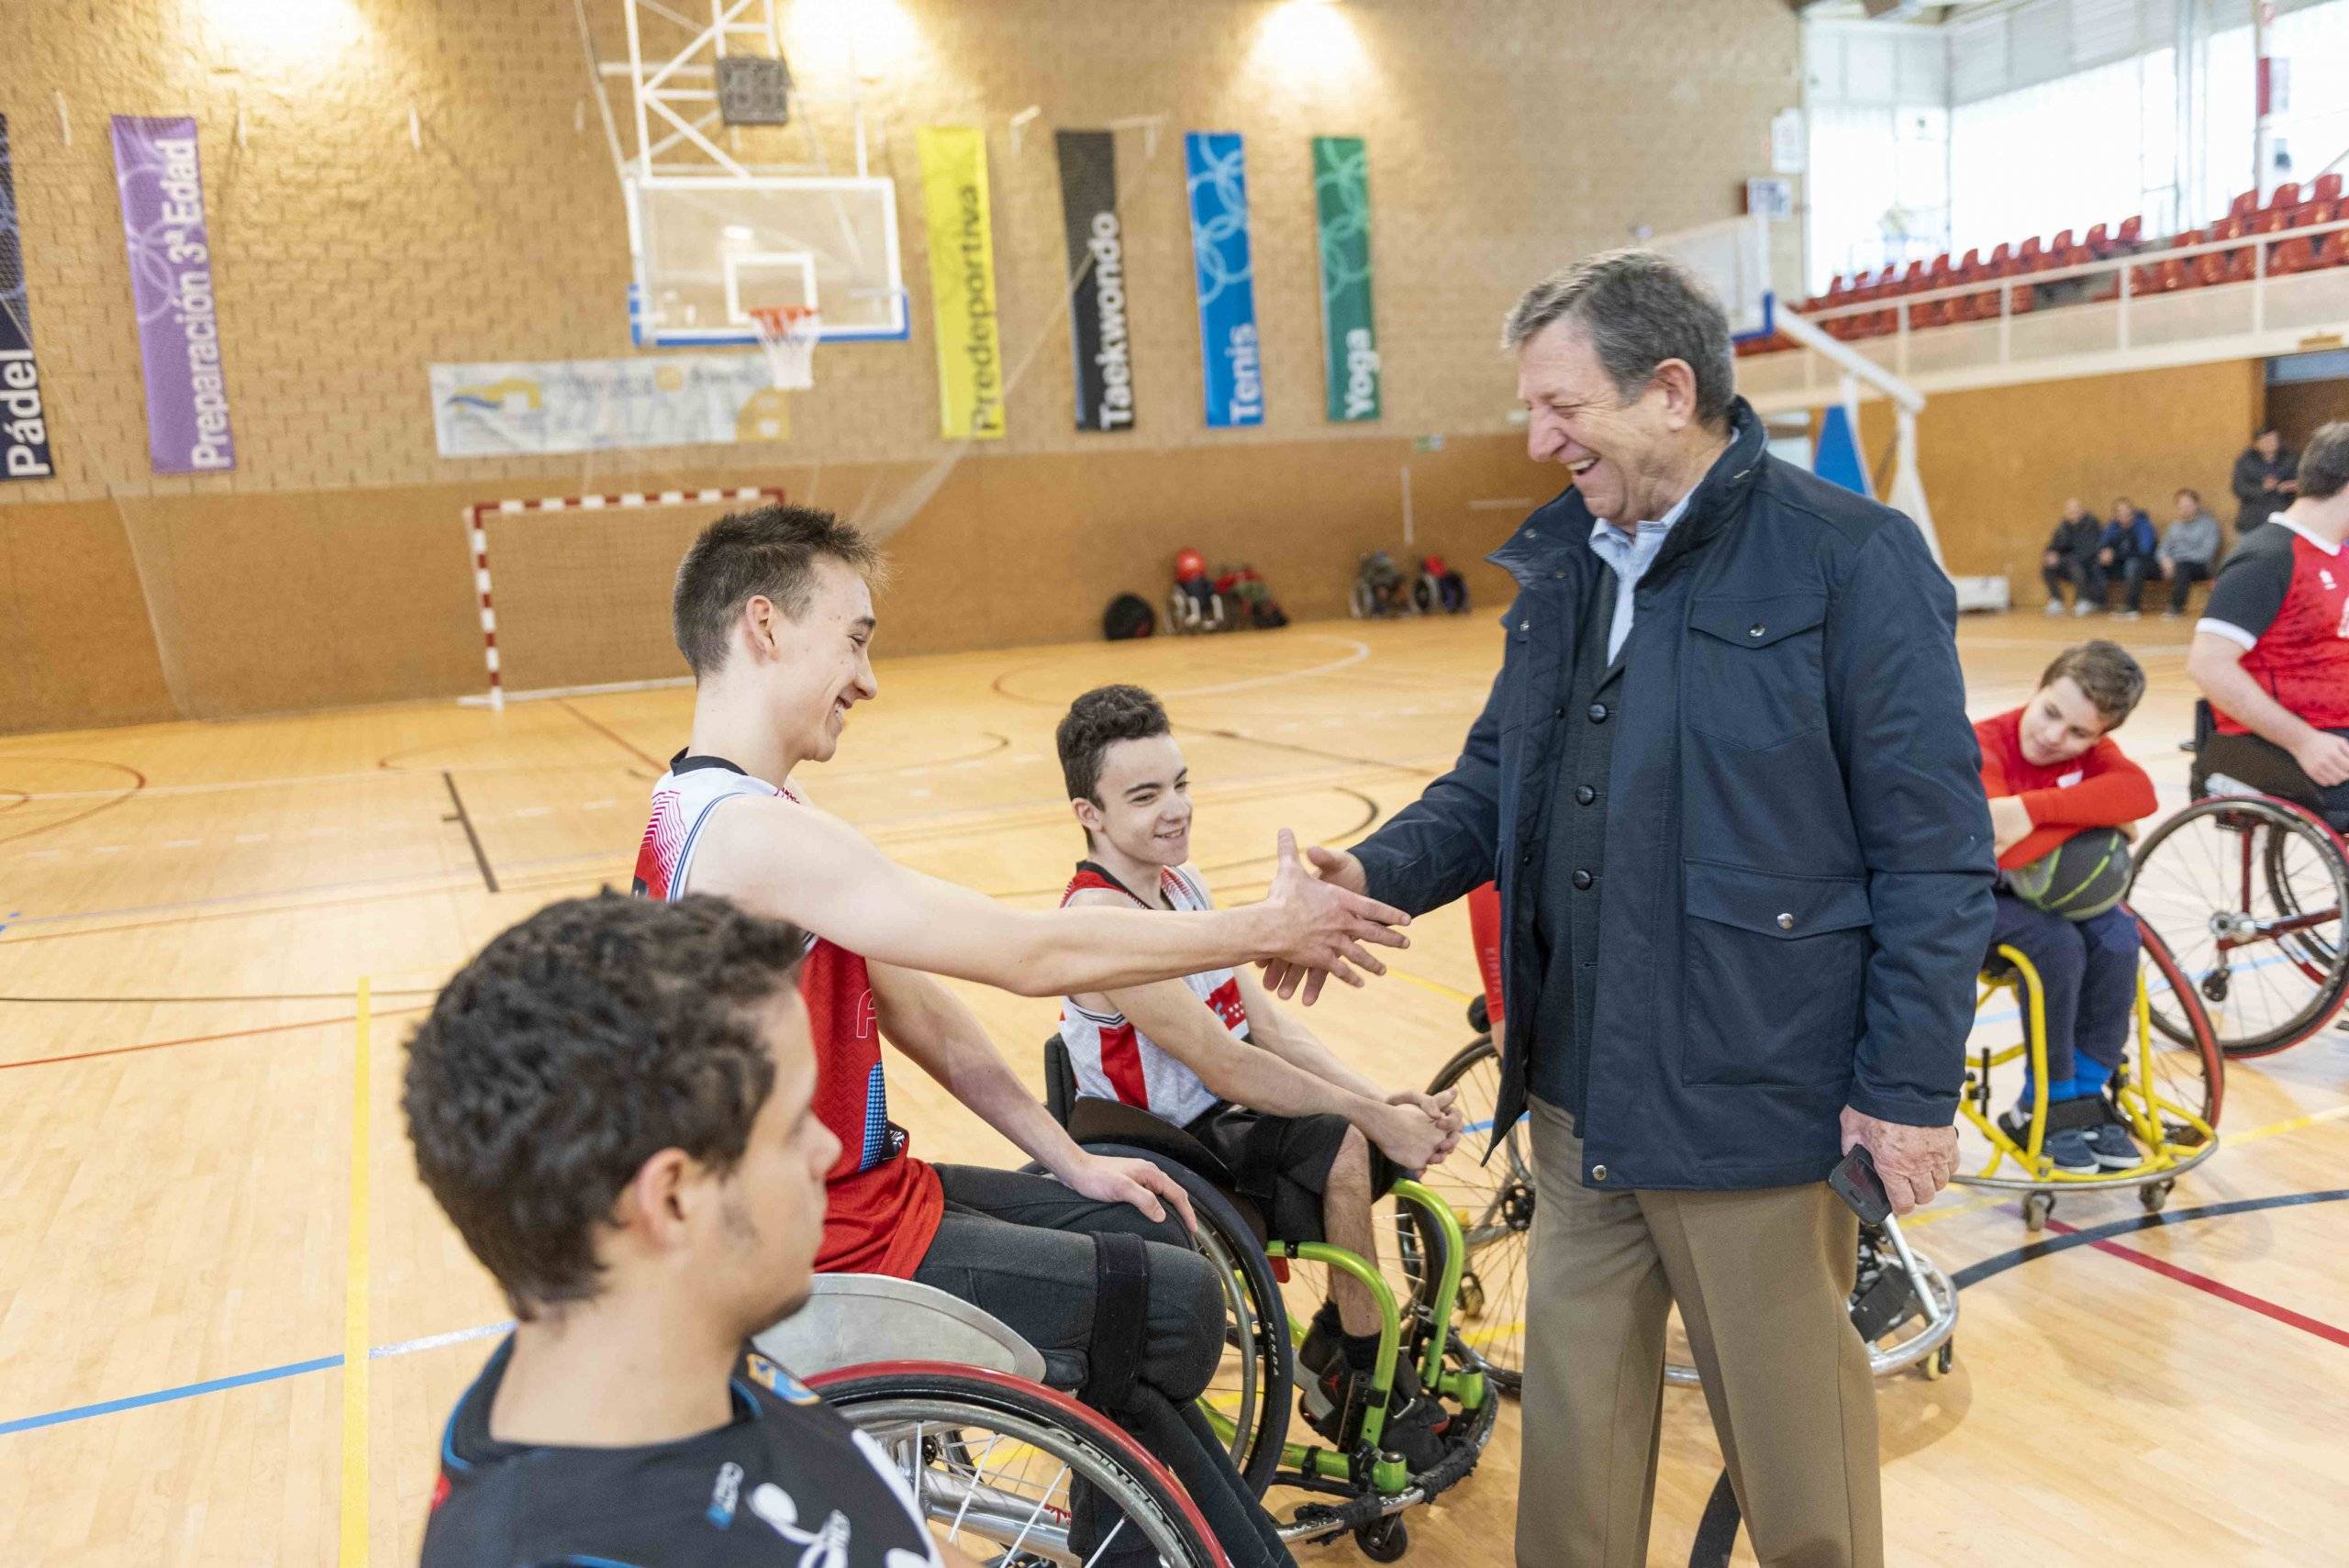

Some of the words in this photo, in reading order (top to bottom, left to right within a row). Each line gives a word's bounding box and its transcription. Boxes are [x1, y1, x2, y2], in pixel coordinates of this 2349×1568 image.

[156, 139, 200, 227] Edad
[173, 271, 229, 471] Preparación
[956, 185, 1001, 432] Predeportiva
[1087, 212, 1132, 430] Taekwondo
[0, 349, 51, 476] Pádel
[1225, 323, 1262, 423] Tenis
[1344, 328, 1379, 419] Yoga
